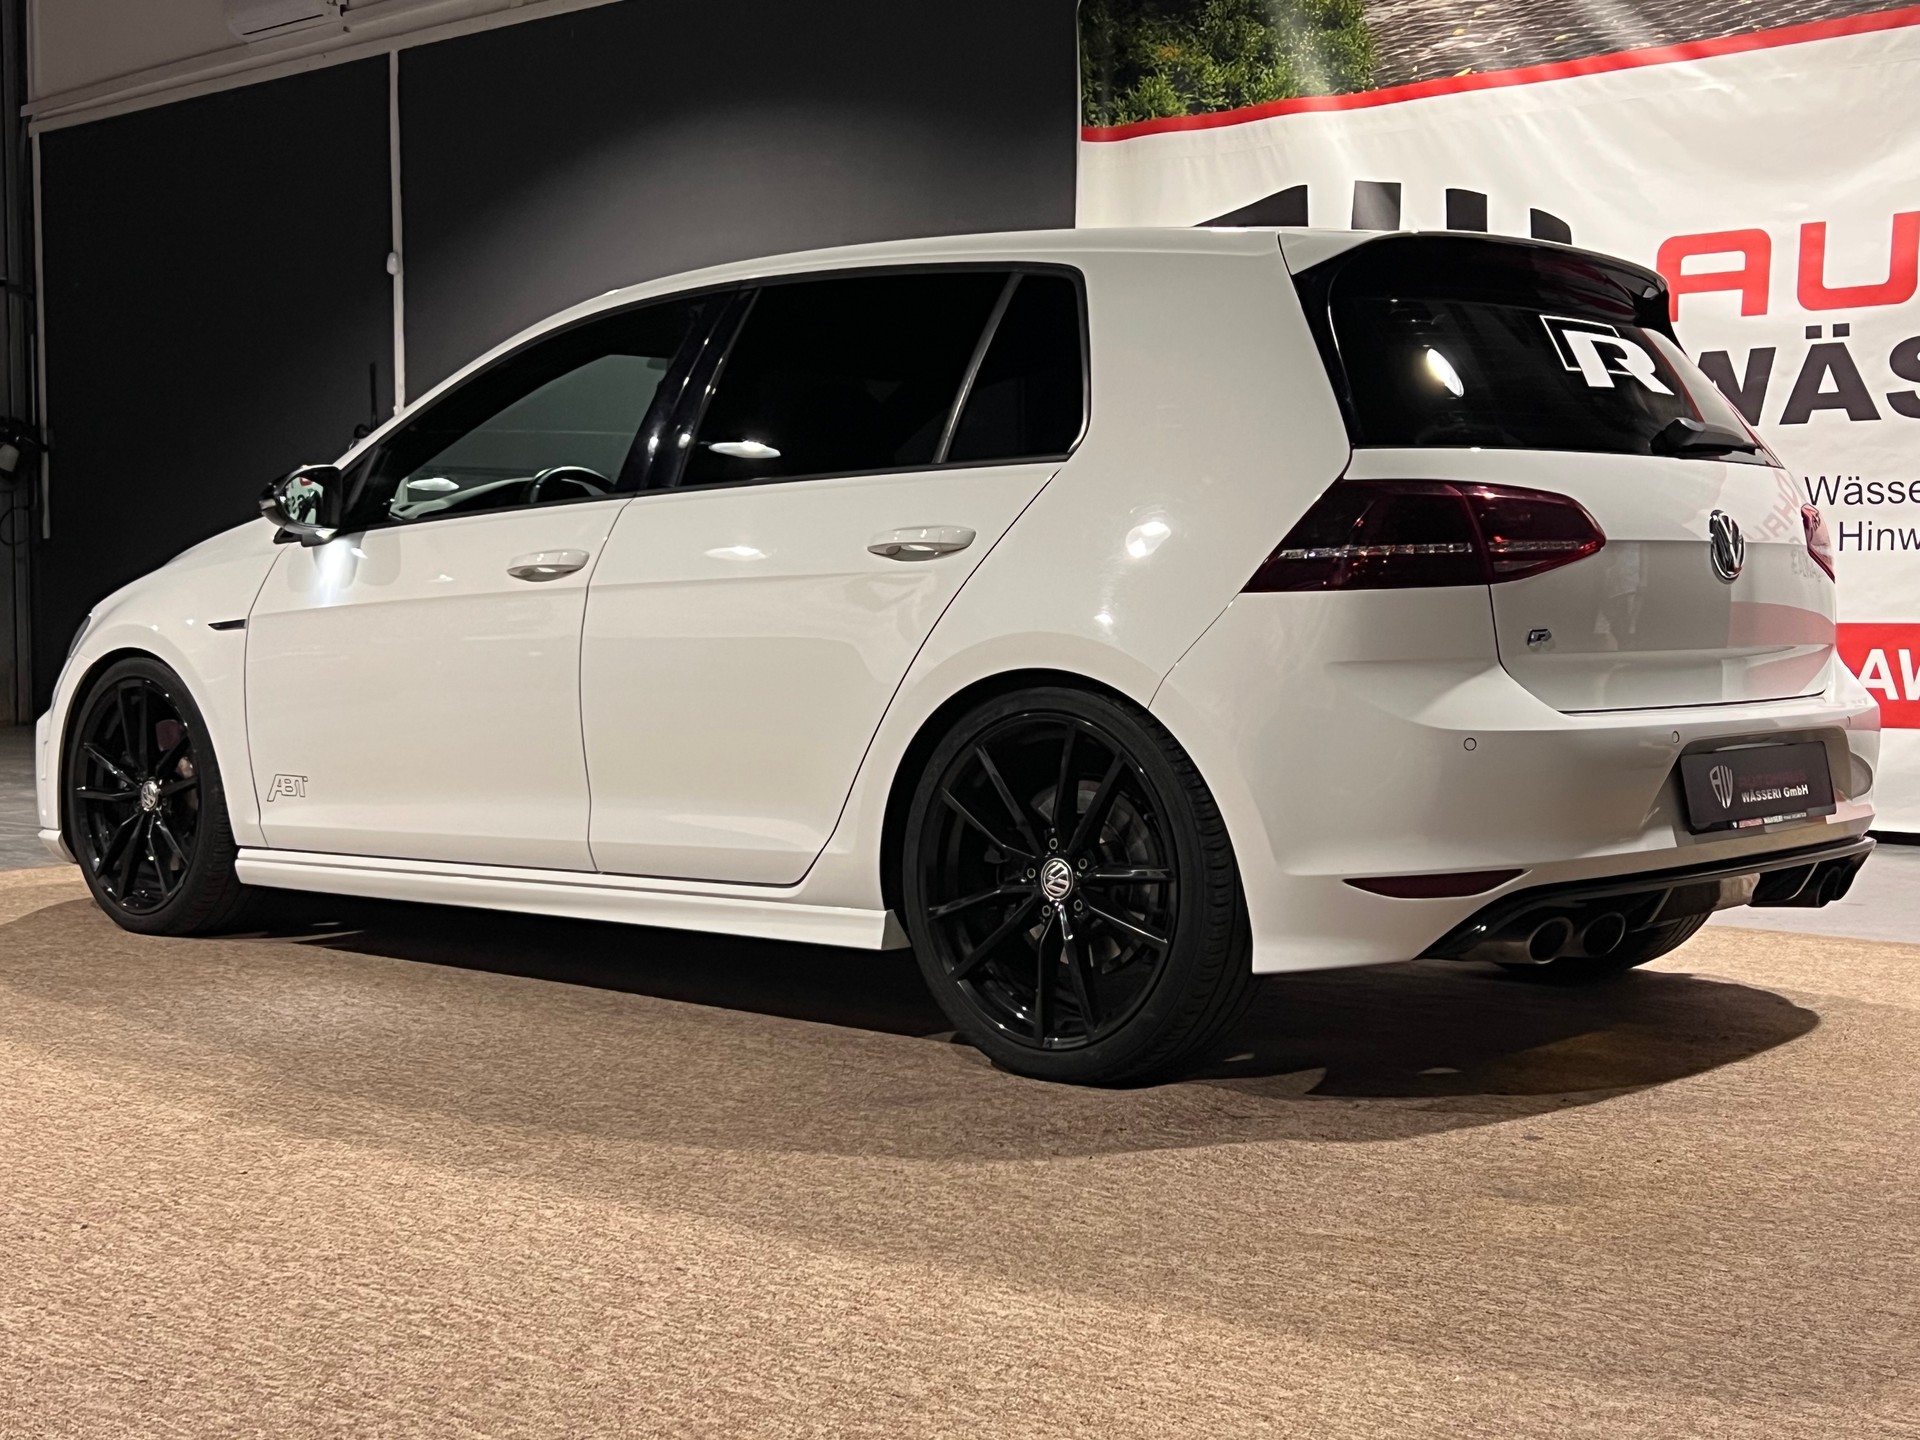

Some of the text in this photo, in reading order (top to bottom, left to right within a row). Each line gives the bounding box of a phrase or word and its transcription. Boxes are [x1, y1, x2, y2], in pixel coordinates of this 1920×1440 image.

[1656, 211, 1920, 322] AU
[1560, 328, 1675, 396] R
[1839, 521, 1920, 552] Hinw
[267, 774, 309, 802] ABT
[1783, 784, 1809, 798] GmbH
